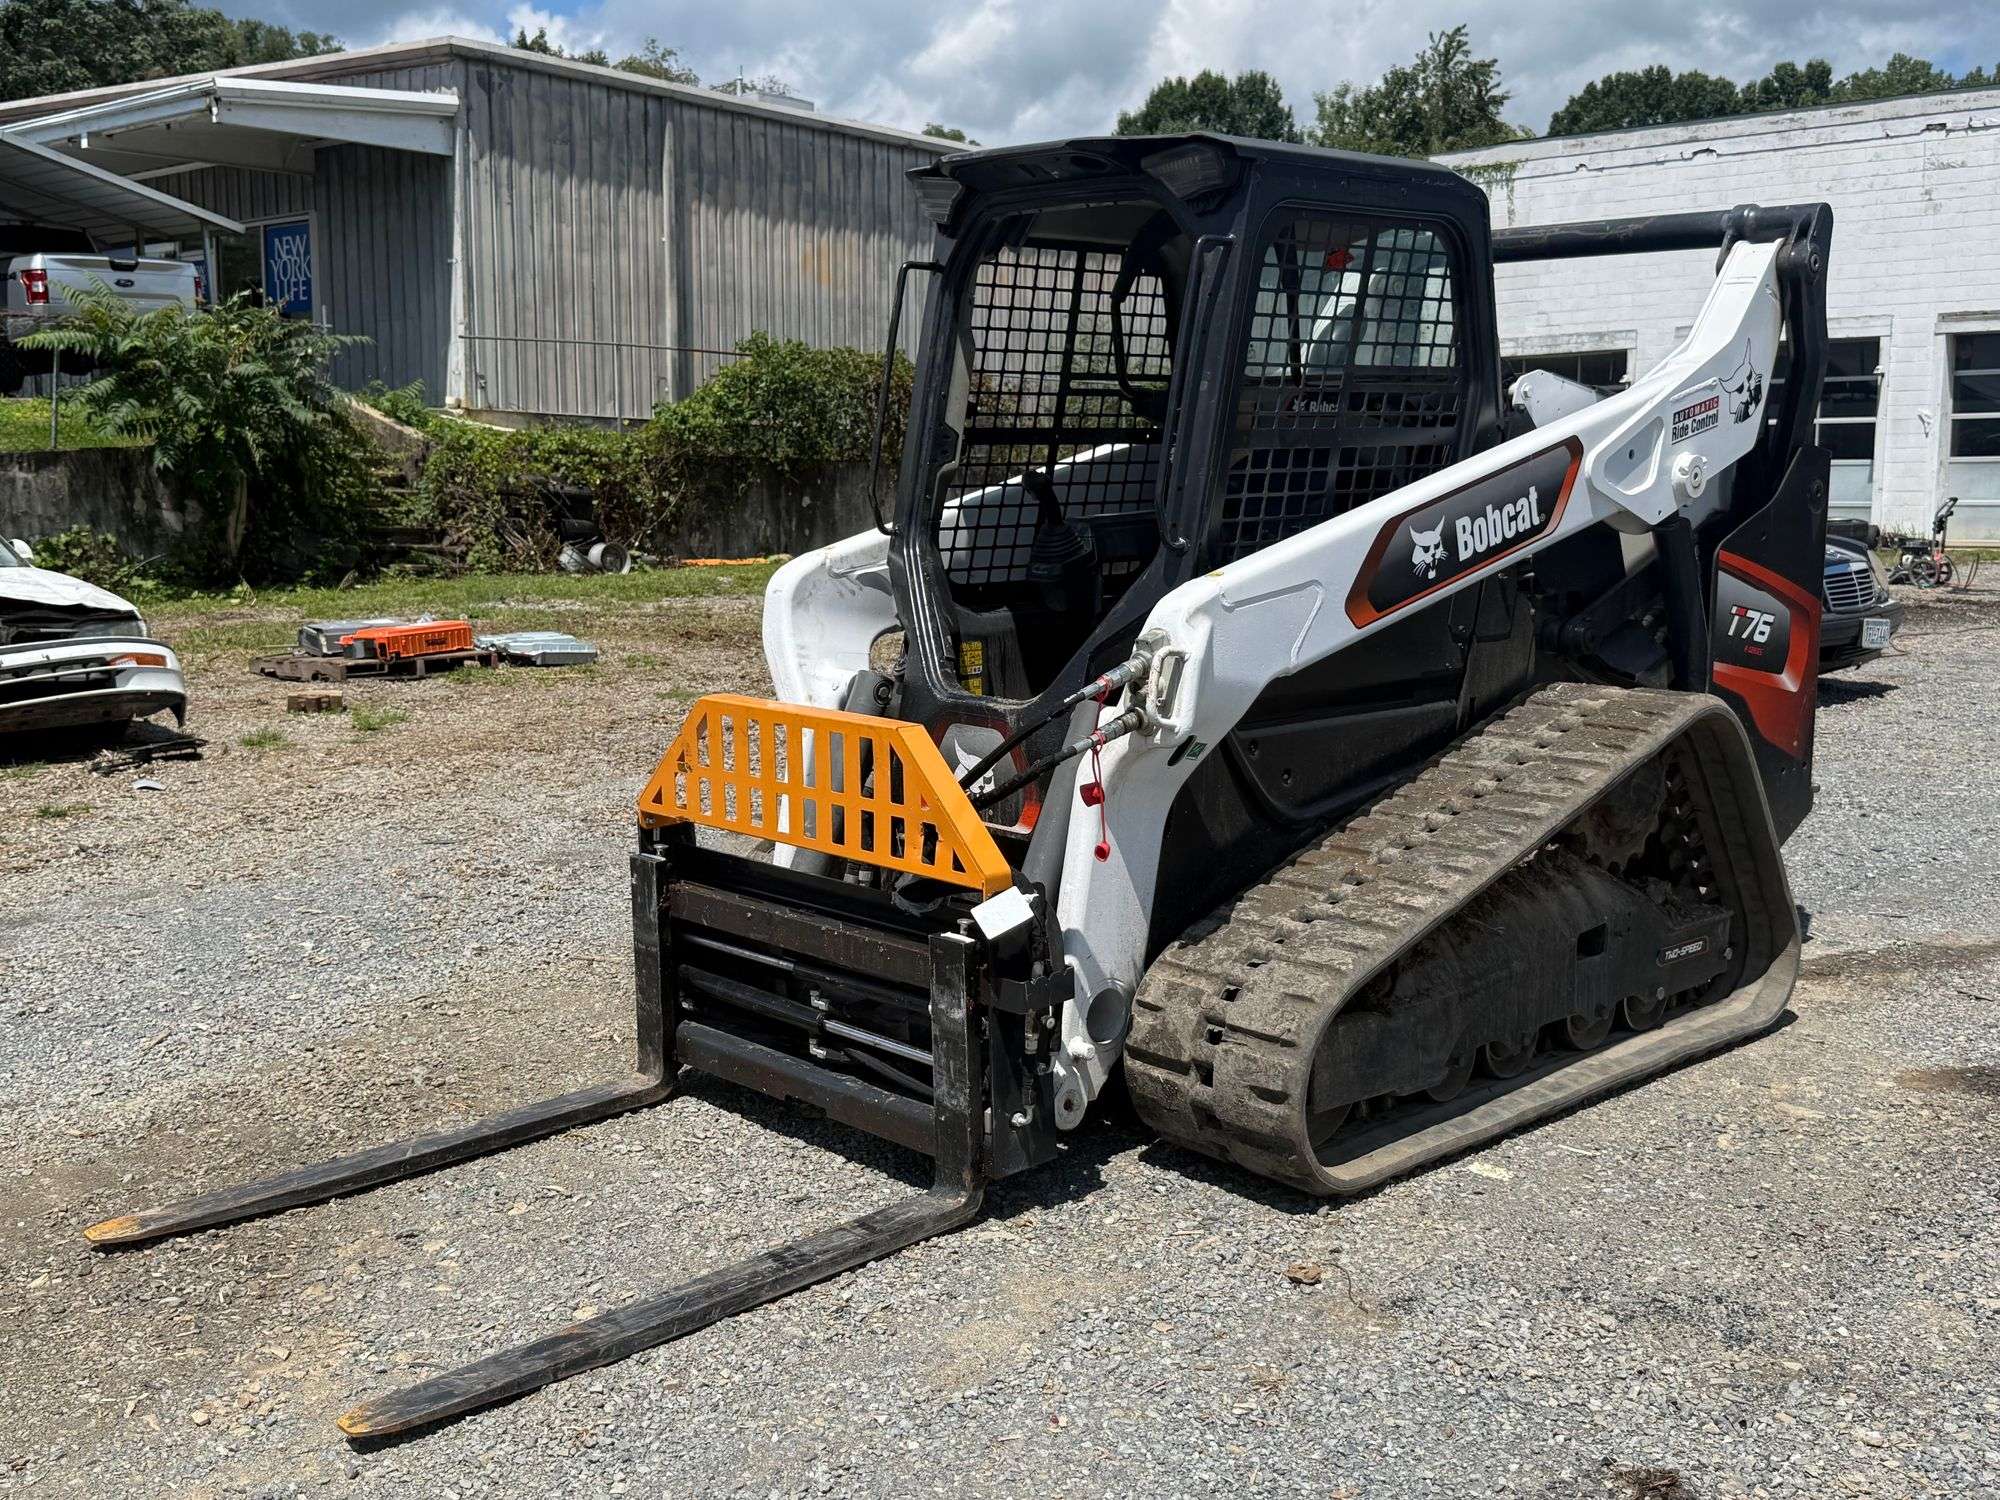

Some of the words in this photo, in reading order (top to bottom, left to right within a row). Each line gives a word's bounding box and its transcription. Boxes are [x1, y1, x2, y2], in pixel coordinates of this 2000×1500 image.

[274, 234, 307, 260] NEW
[270, 255, 312, 281] YORK
[276, 279, 308, 302] LIFE
[1673, 397, 1719, 424] AUTOMATIC
[1672, 423, 1689, 441] Ride
[1691, 410, 1719, 433] Control
[1455, 485, 1541, 562] Bobcat
[1727, 606, 1775, 643] T76
